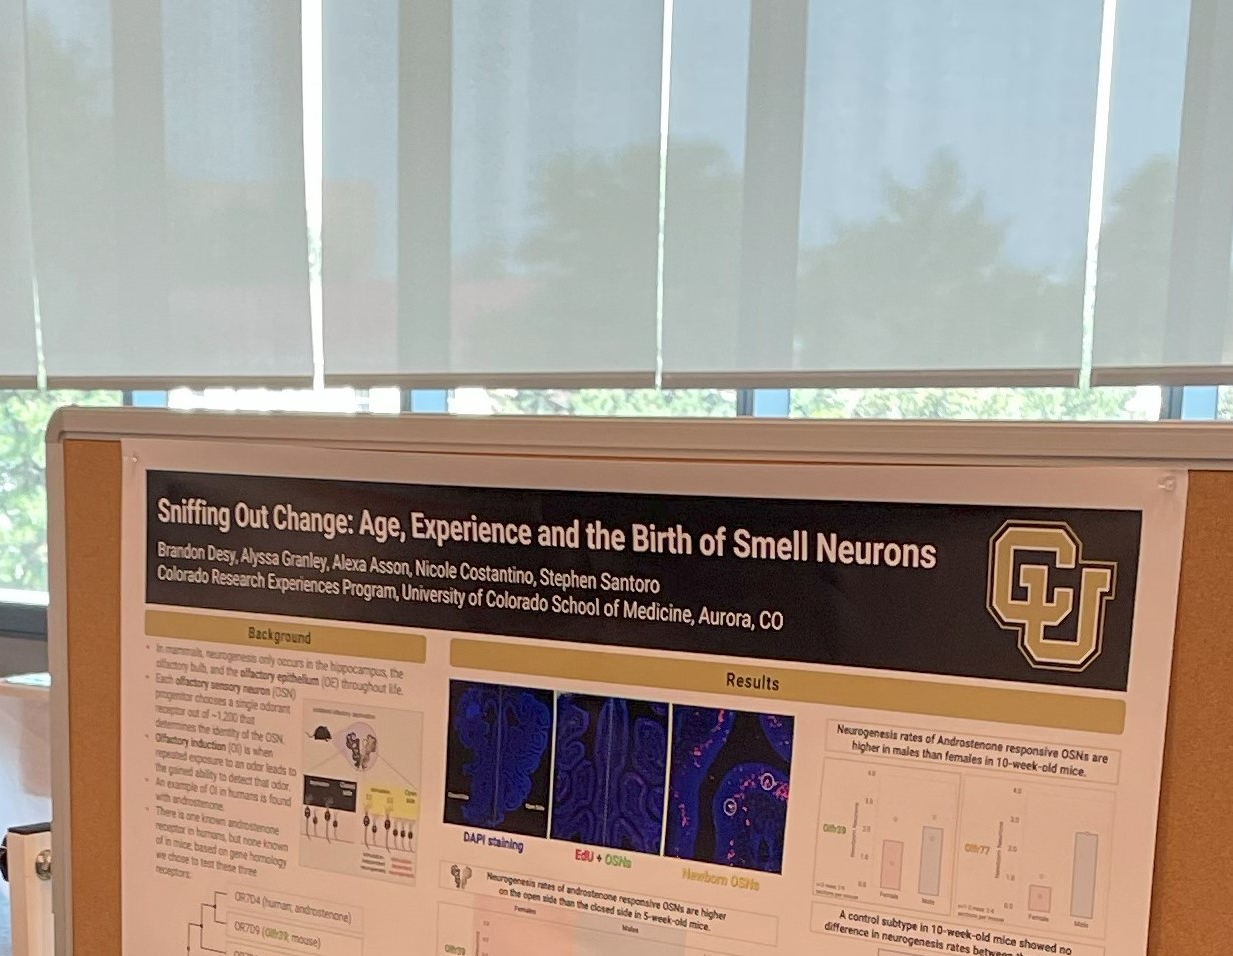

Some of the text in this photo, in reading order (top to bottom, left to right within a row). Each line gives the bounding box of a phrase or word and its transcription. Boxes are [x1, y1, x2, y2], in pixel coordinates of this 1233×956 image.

[157, 497, 937, 568] Sniffing Out Change: Age, Experience and the Birth of Smell Neurons
[157, 541, 660, 593] Brandon Desy, Alyssa Granley, Alexa Asson, Nicole Costantino, Stephen Santoro
[157, 564, 783, 631] Colorado Research Experiences Program, University of Colorado School of Medicine, Aurora, CO
[248, 626, 312, 645] Background
[726, 672, 780, 692] Results
[836, 723, 1108, 764] Neurogenesis rates of Androstenone responsive OSNs are
[851, 740, 880, 754] higher
[881, 743, 890, 754] in
[892, 745, 919, 757] males
[922, 748, 942, 760] than
[944, 750, 982, 764] females
[984, 755, 994, 766] in
[996, 757, 1058, 773] 10-week-old
[463, 831, 524, 853] DAPI staining
[824, 921, 869, 937] difference
[871, 928, 879, 939] in
[881, 932, 943, 949] neurogenesis
[945, 943, 970, 954] rates
[839, 909, 1072, 955] A control subtype in 10-week-old mice showed no
